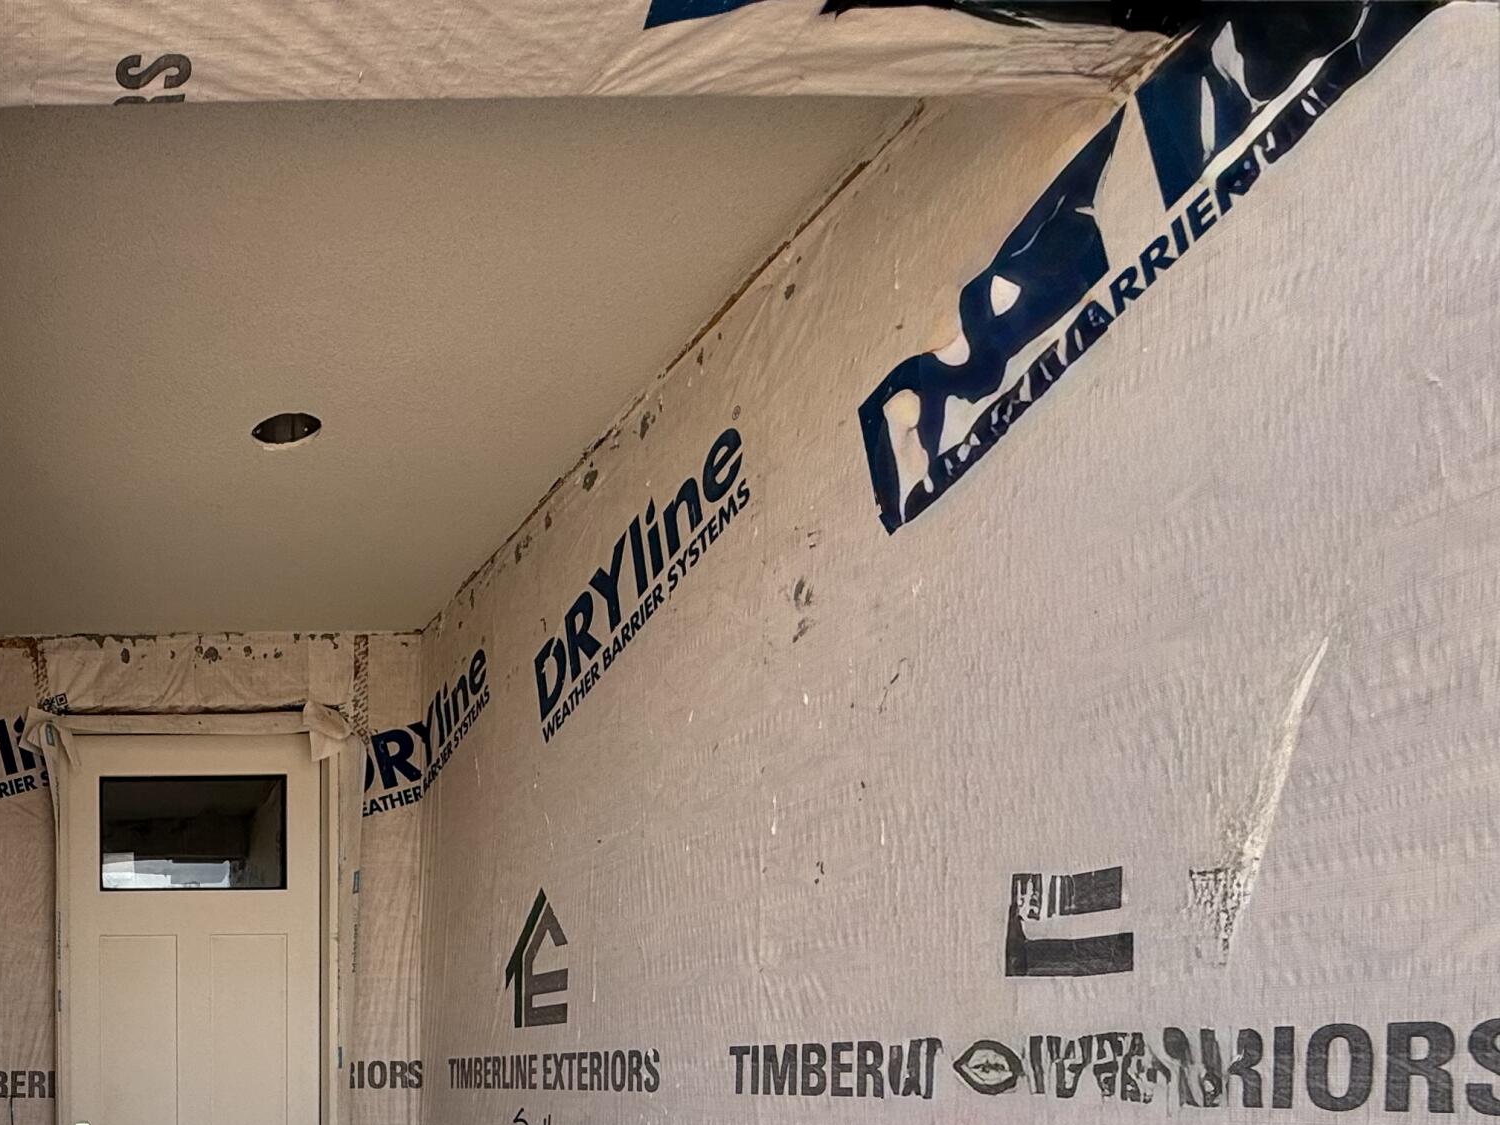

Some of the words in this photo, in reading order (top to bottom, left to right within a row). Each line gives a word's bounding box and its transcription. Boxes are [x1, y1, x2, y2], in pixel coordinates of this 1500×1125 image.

[534, 427, 745, 723] DRYline
[542, 667, 601, 744] WEATHER
[602, 584, 665, 673] BARRIER
[667, 477, 751, 594] SYSTEMS
[453, 684, 490, 750] SYSTEMS
[449, 1053, 537, 1090] TIMBERLINE
[542, 1047, 660, 1093] EXTERIORS
